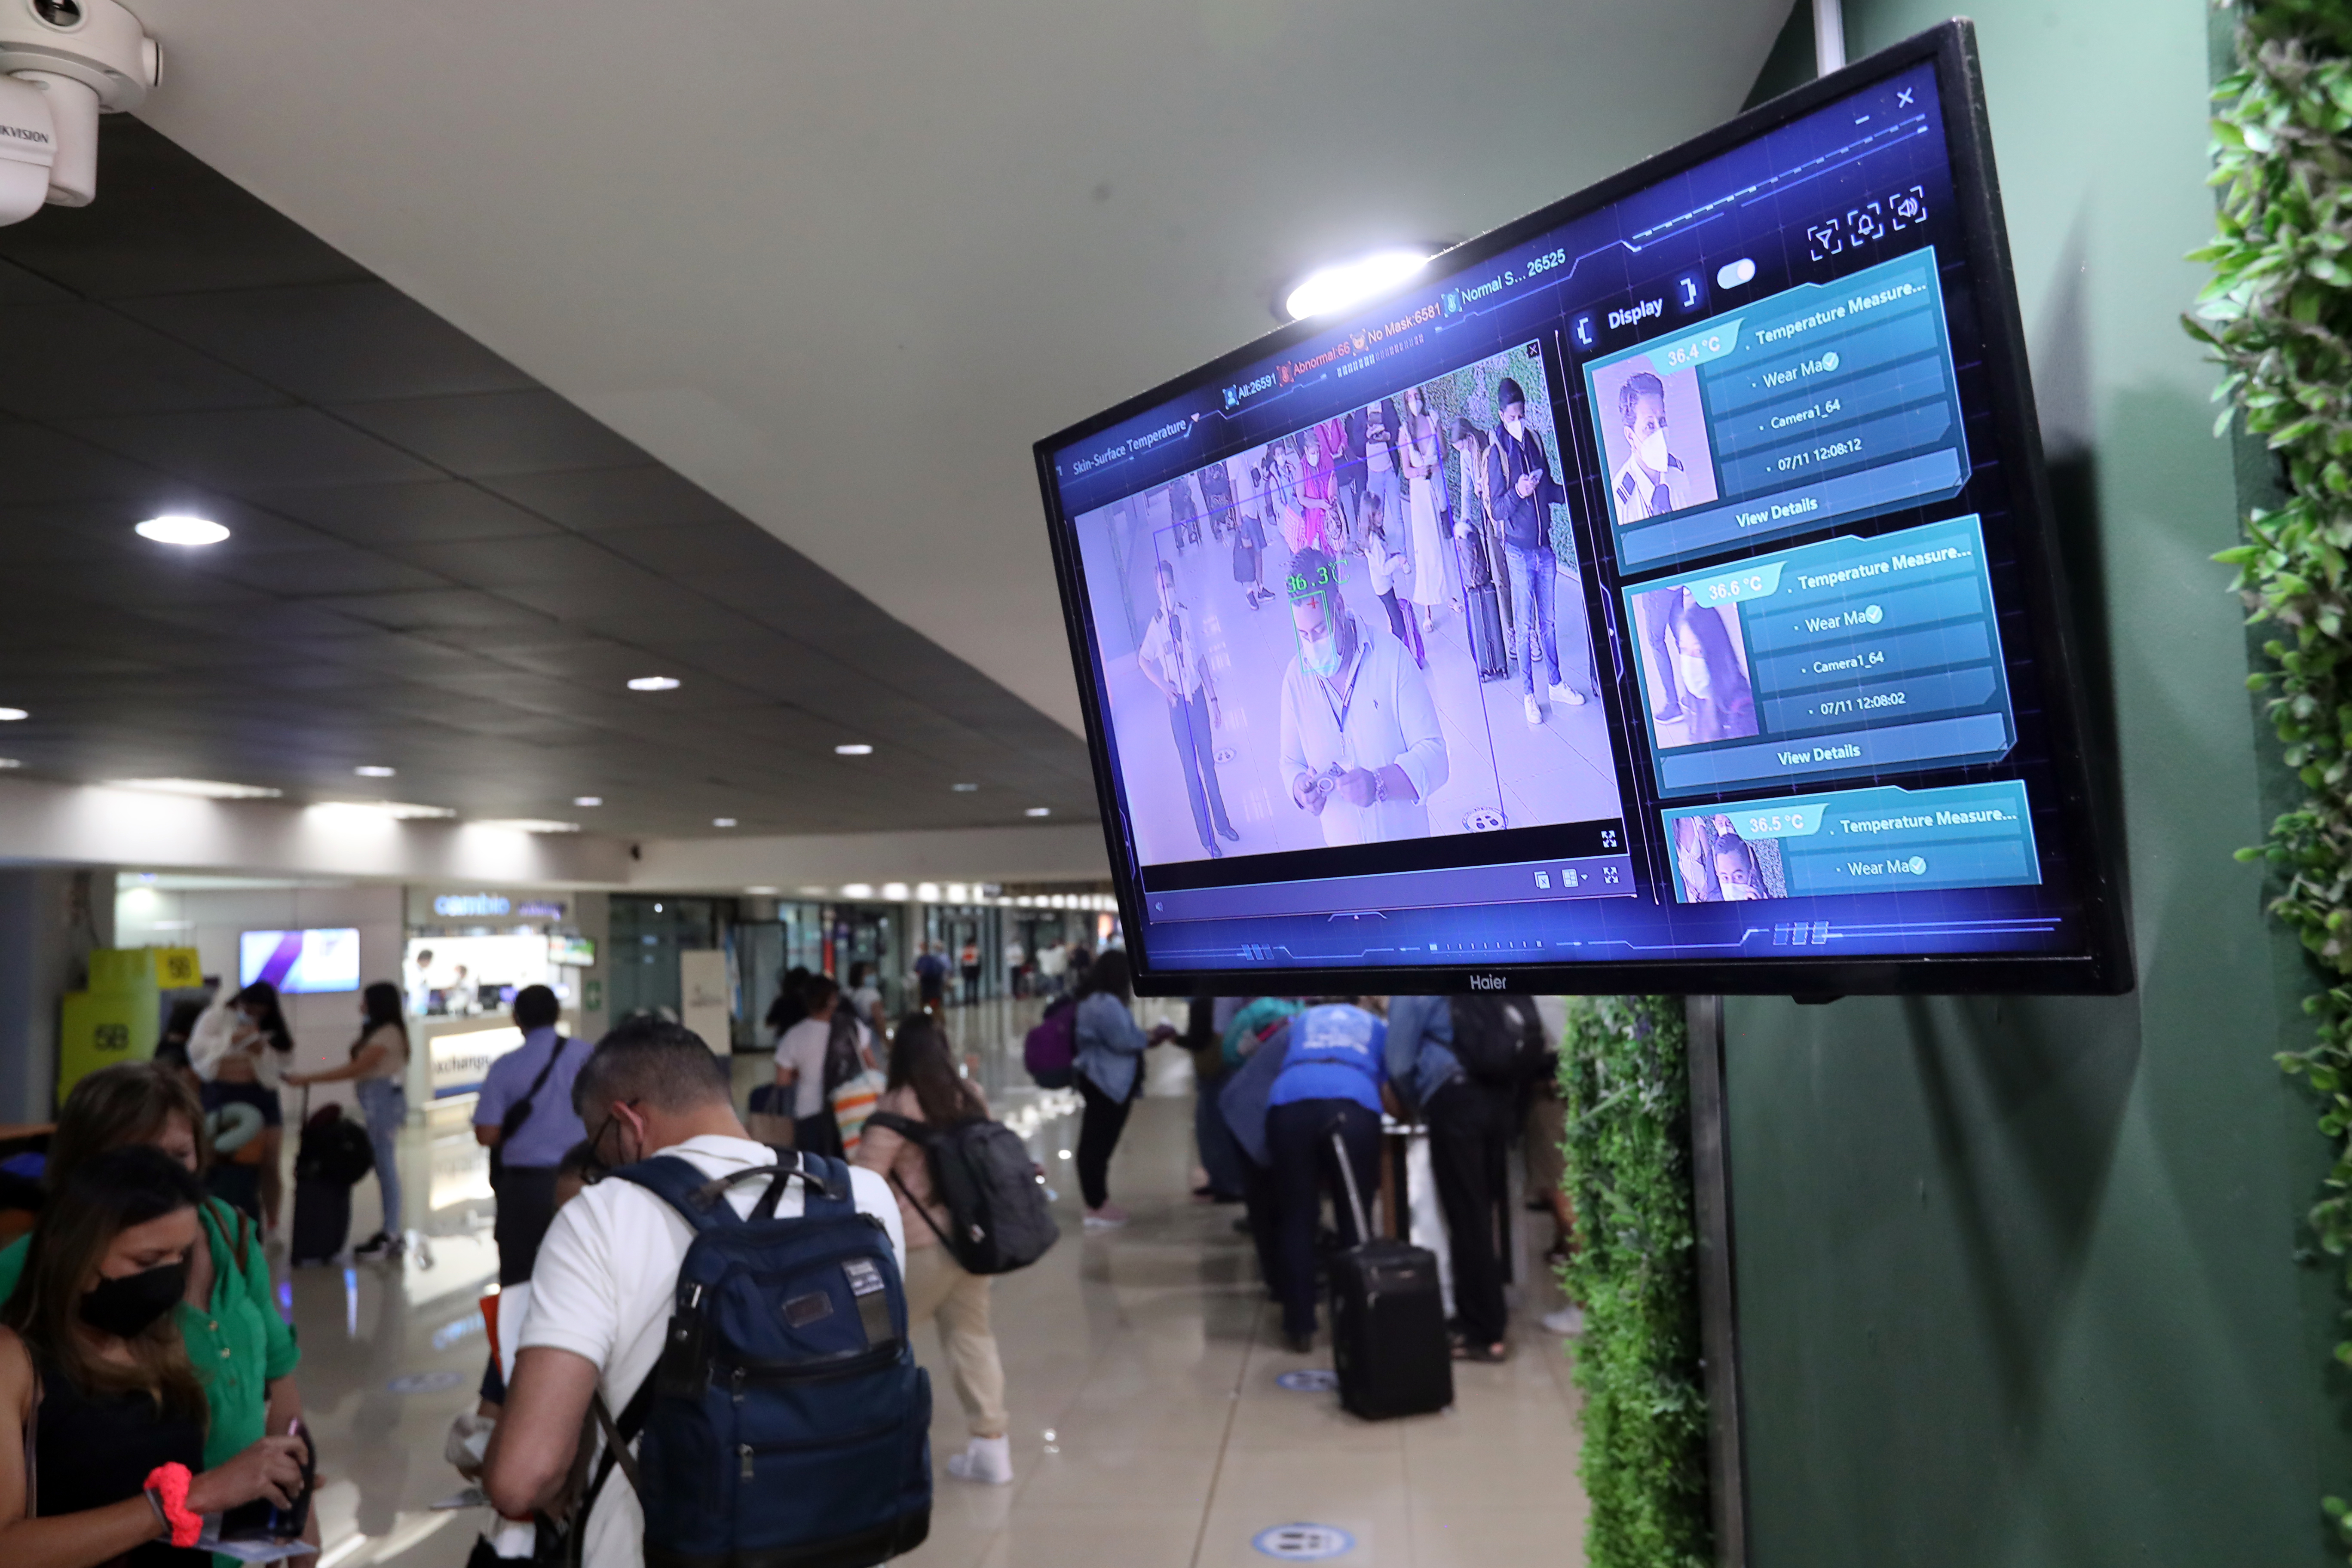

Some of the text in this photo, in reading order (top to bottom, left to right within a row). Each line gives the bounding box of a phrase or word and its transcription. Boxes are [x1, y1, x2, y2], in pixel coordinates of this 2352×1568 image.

[1461, 276, 1502, 304] Normal
[1527, 248, 1566, 277] 26525
[1368, 302, 1440, 344] No Mask:6581
[1608, 298, 1663, 329] Display
[1755, 283, 1926, 345] Temperature Measure...
[1293, 341, 1351, 376] Abnormal:66
[1668, 336, 1721, 366] 36.4 °C
[1238, 372, 1277, 400] All:26591
[1763, 368, 1797, 388] Wear
[1771, 398, 1841, 429] Camera1_64
[1073, 420, 1186, 475] Skin-Surface Temperature
[1778, 438, 1862, 471] 07/11 12:08:12
[1736, 497, 1818, 527] View Details
[1798, 546, 1972, 590] Temperature Measure...
[1709, 576, 1762, 600] 36.6 °C
[1805, 616, 1841, 633] Wear
[1813, 651, 1884, 673] Camera1_64
[1820, 692, 1906, 715] 07/11 12:08:02
[1777, 744, 1861, 766] View Details
[1749, 814, 1804, 833] 36.5 °C
[1840, 808, 2017, 834] Temperature Measure...
[1847, 861, 1882, 876] Wear
[1470, 974, 1507, 990] Haier
